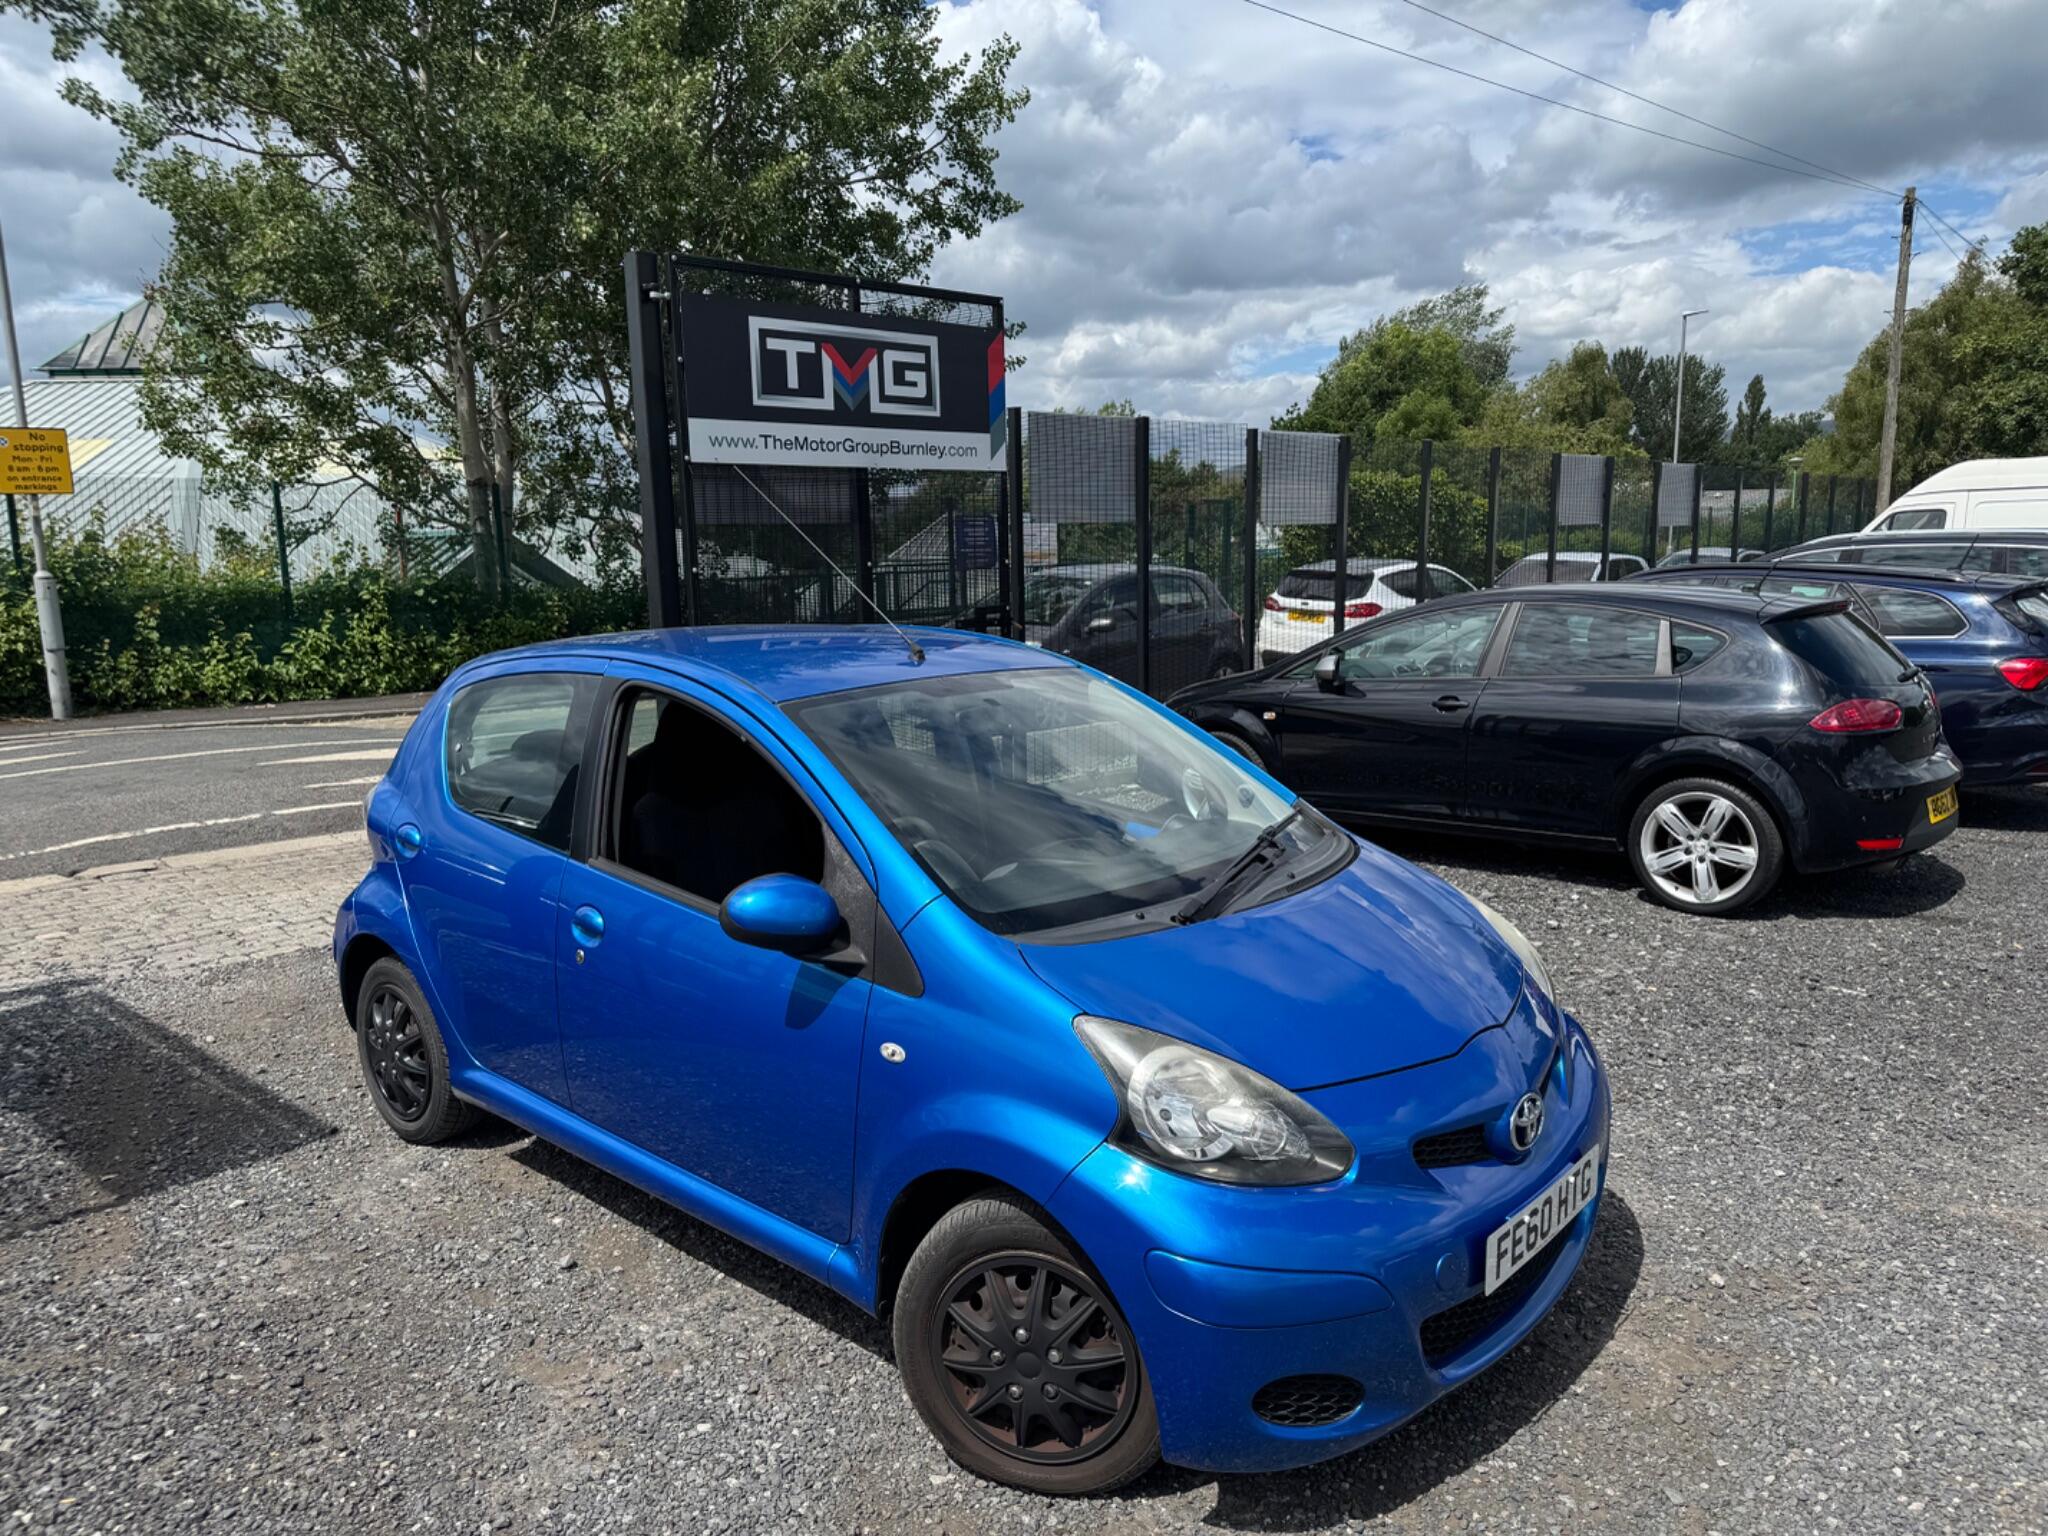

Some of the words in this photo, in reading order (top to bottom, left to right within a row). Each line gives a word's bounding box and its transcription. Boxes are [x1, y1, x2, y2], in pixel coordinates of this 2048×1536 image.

[766, 337, 928, 411] TMG
[13, 443, 64, 454] stopping
[29, 432, 45, 441] No
[708, 434, 978, 460] www.TheMotorGroupBurnley.com
[1496, 1196, 1552, 1280] FE60
[1557, 1159, 1592, 1225] HTG
